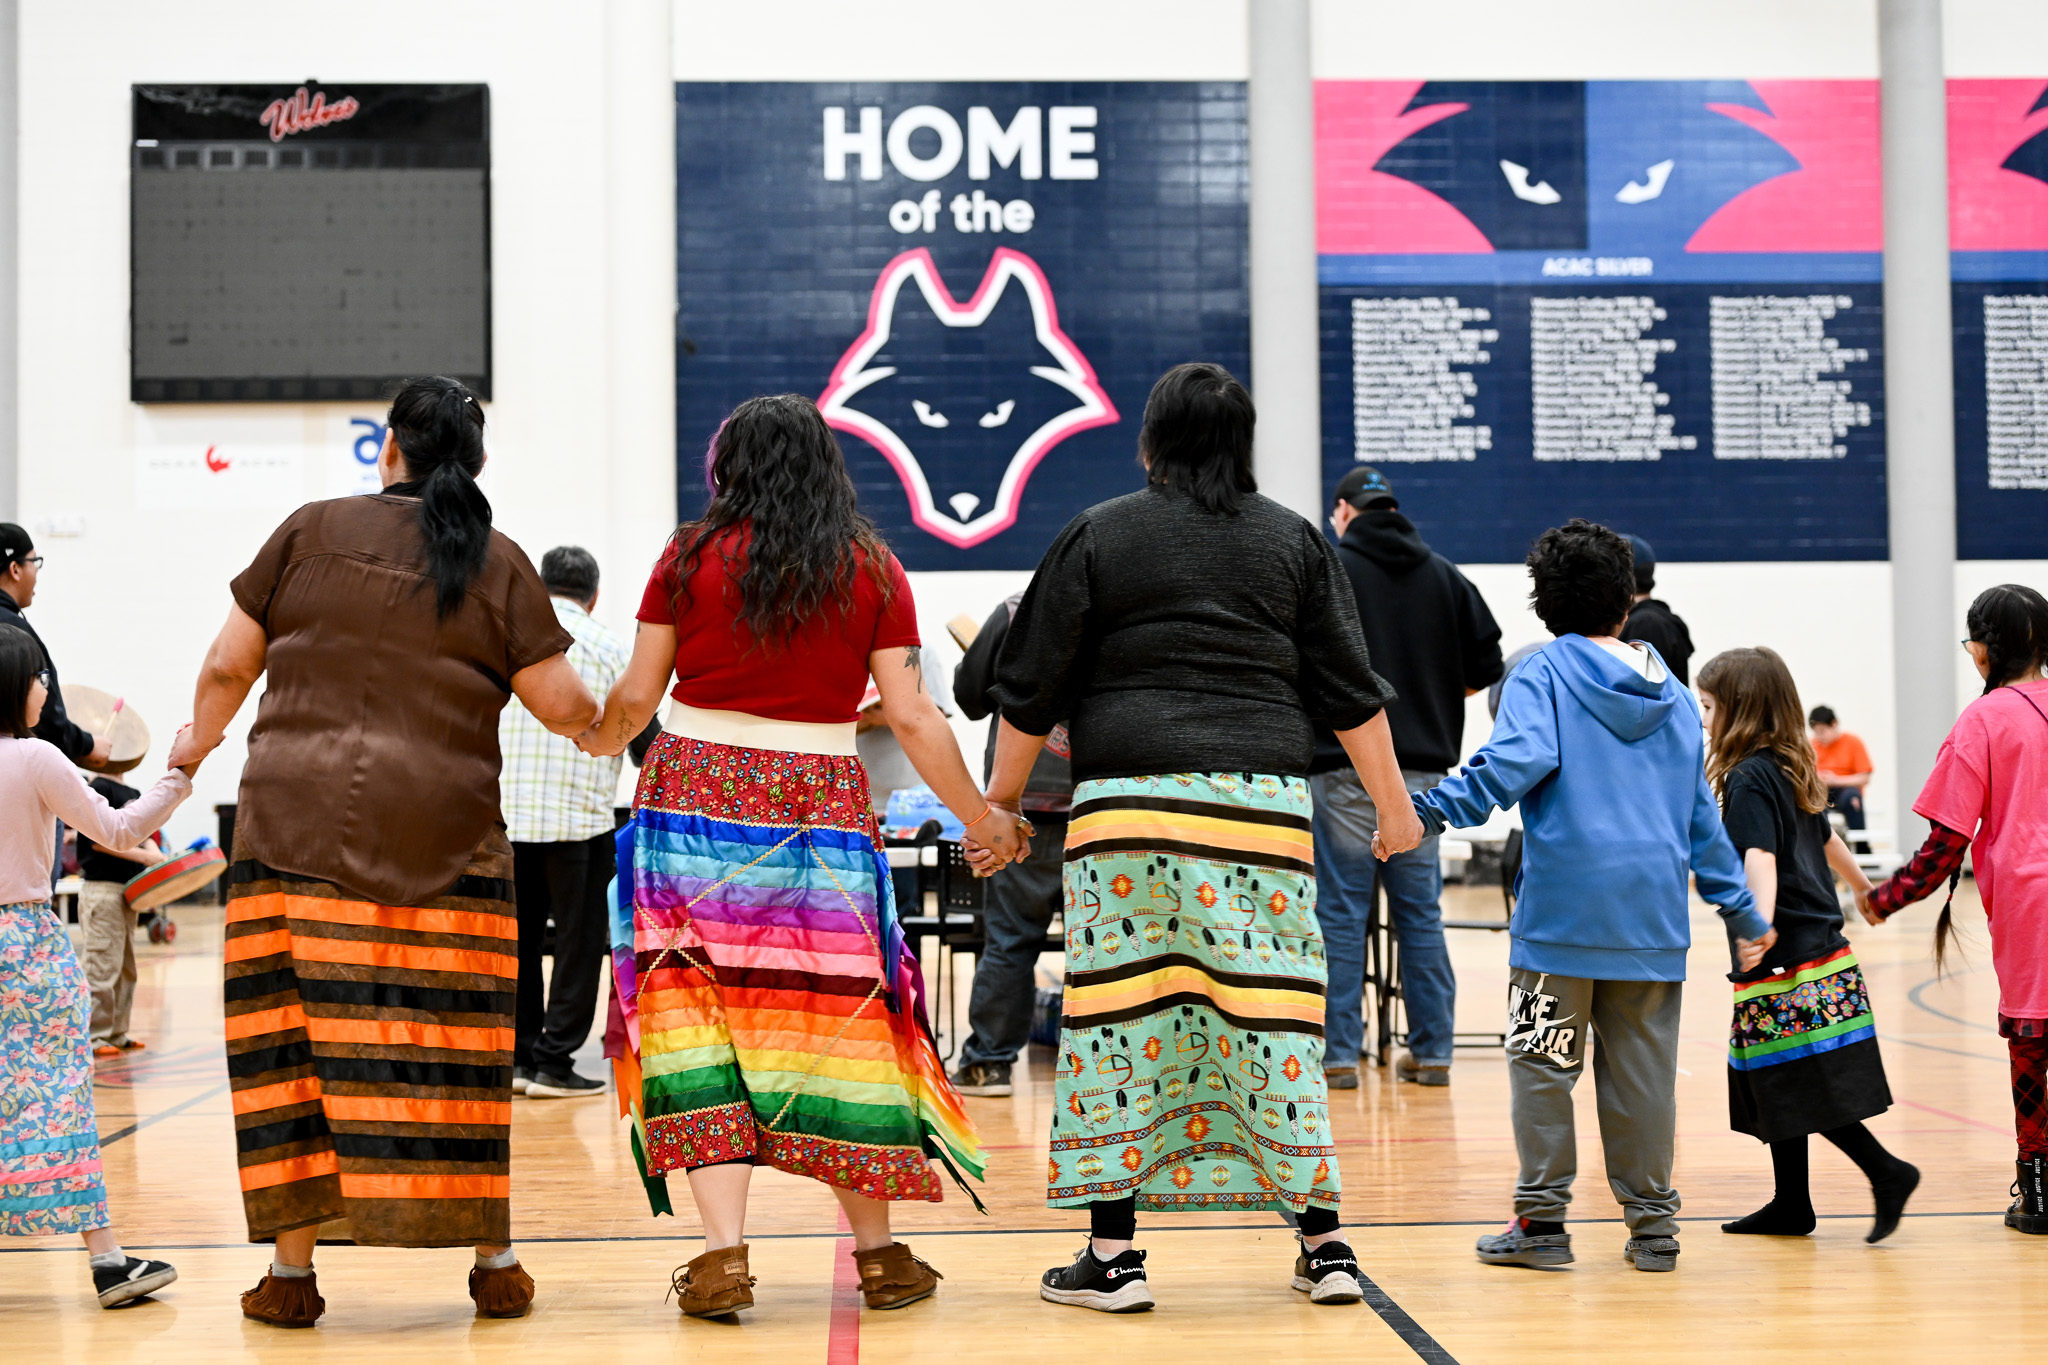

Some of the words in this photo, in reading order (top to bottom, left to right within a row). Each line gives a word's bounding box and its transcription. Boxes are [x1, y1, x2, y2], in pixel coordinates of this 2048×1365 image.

[822, 105, 1099, 181] HOME
[889, 190, 942, 233] of
[949, 190, 1035, 233] the
[1541, 257, 1593, 277] ACAC
[1595, 257, 1653, 276] SILVER
[1521, 1028, 1575, 1054] AIR
